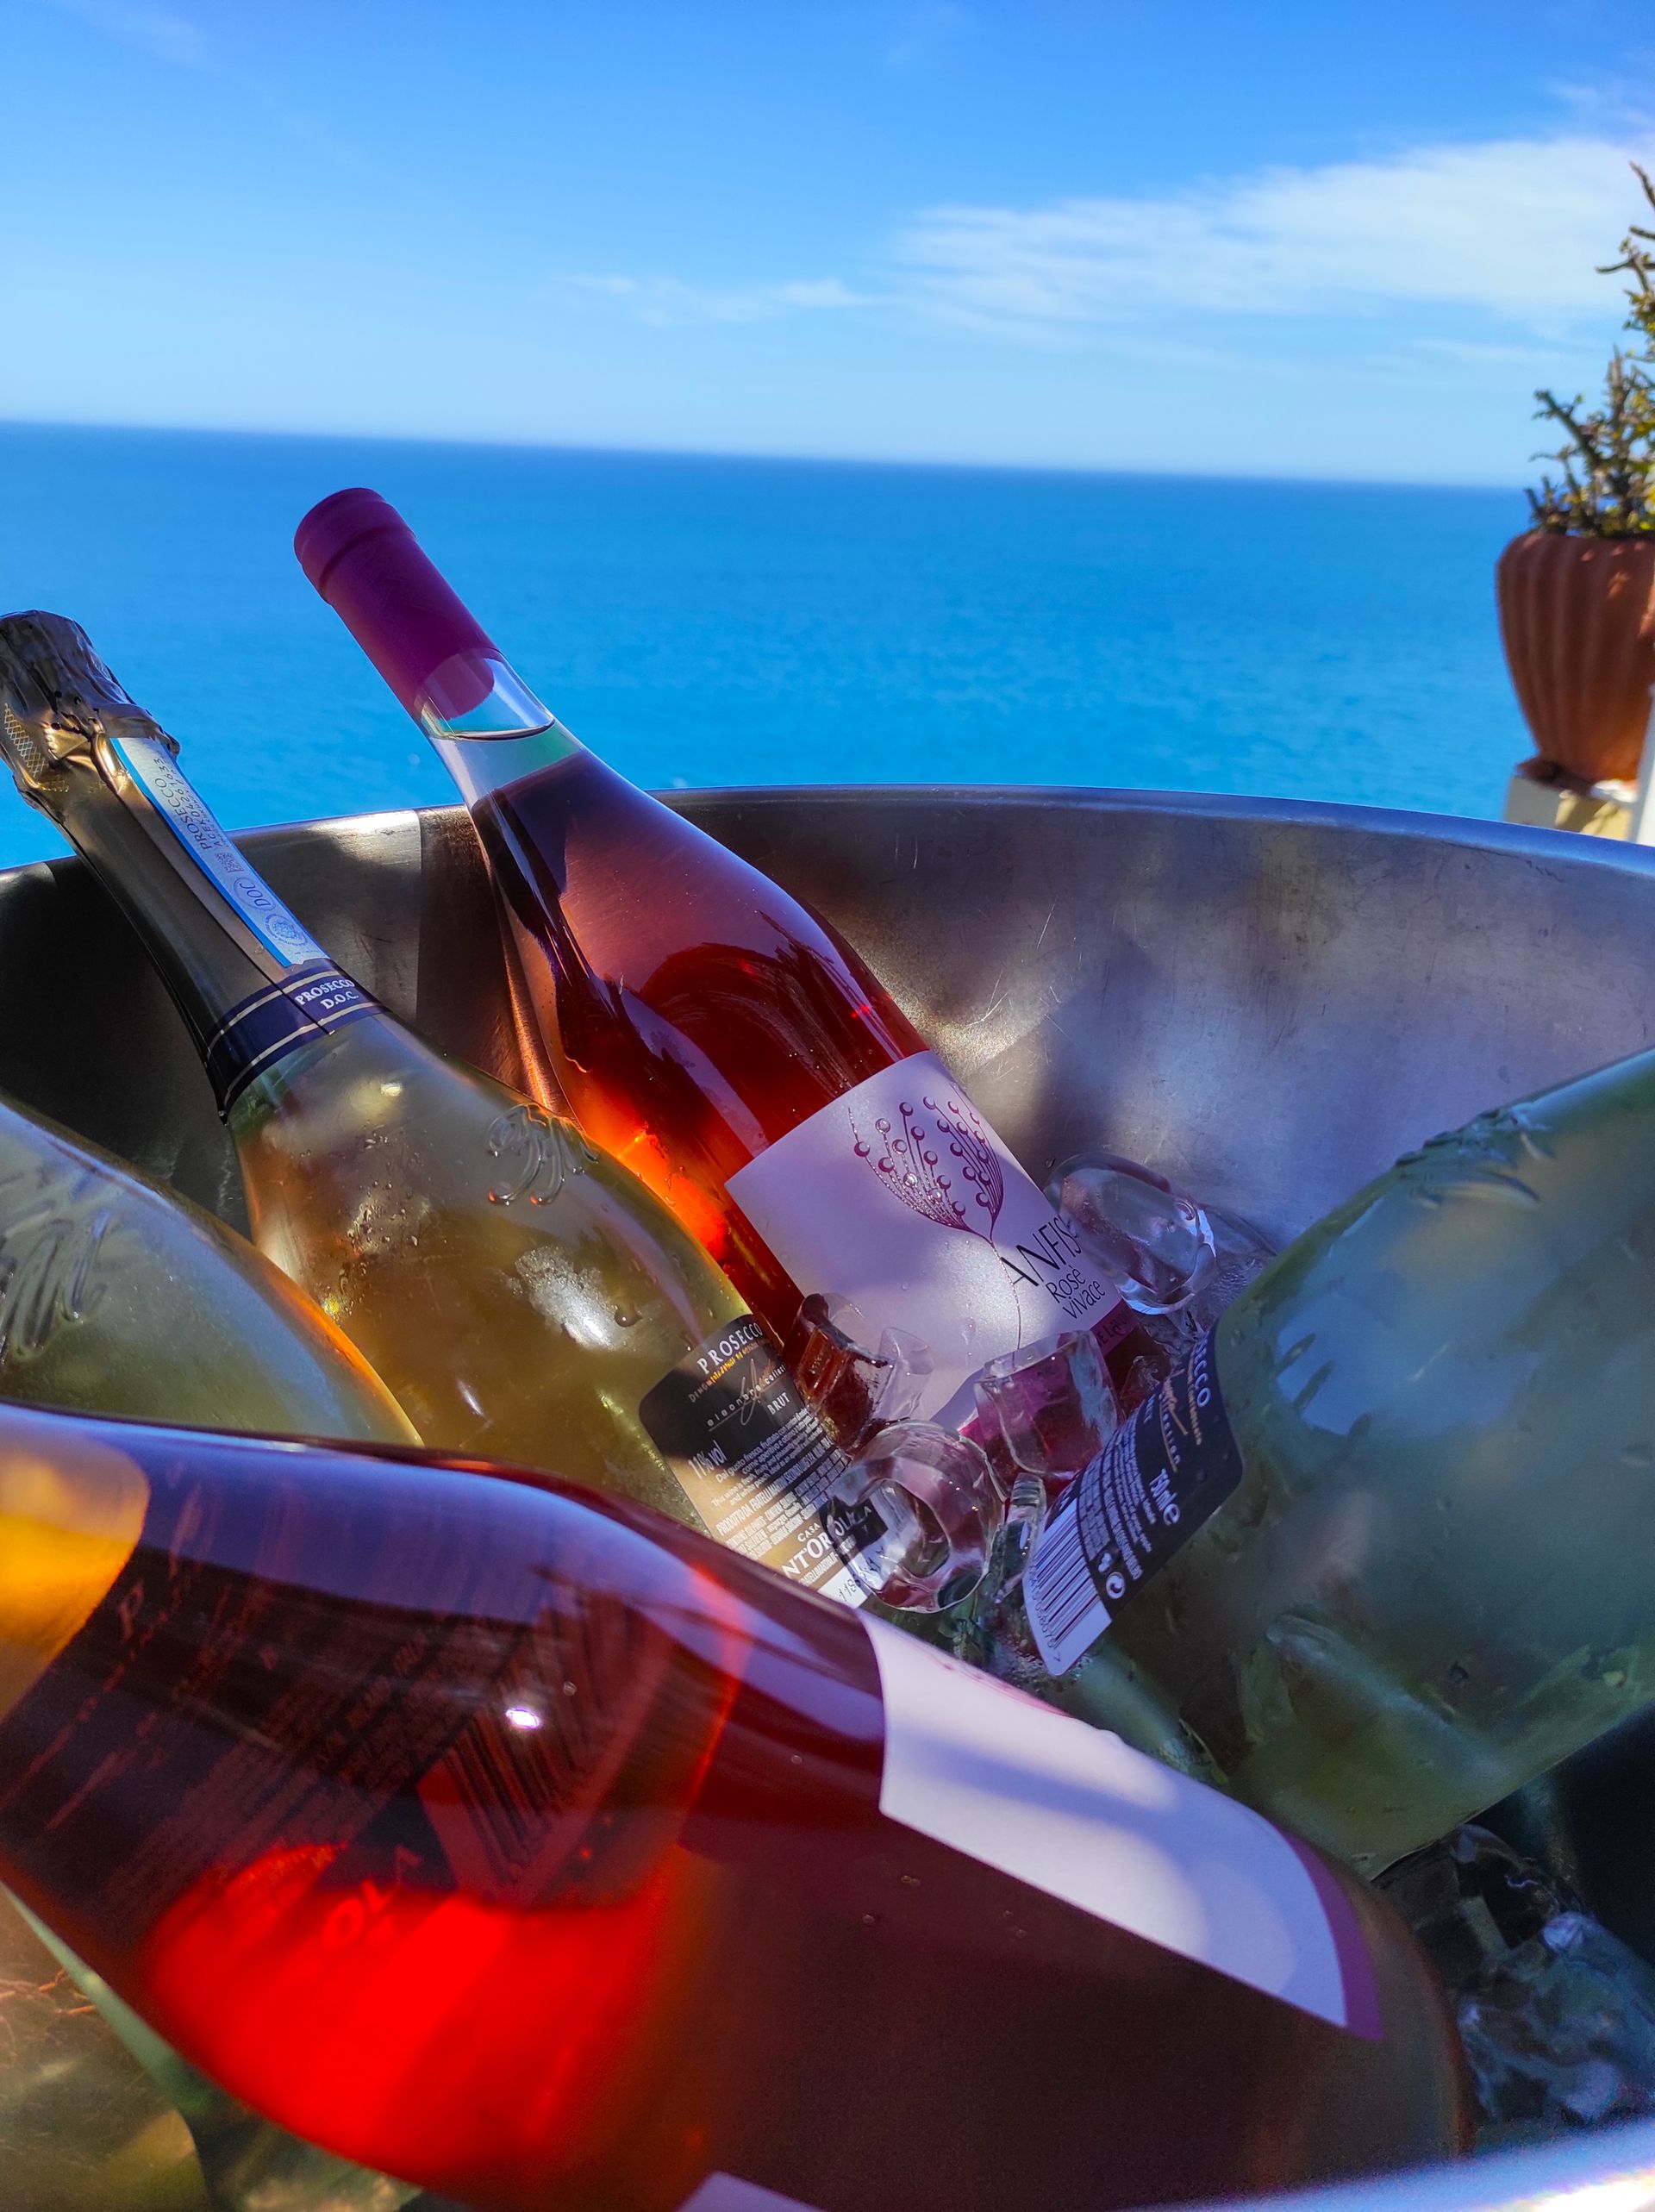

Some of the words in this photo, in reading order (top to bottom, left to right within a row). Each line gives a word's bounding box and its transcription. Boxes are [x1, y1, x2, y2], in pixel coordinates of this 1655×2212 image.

[154, 776, 213, 851] PROSECCO
[240, 881, 271, 908] DOC
[293, 978, 355, 1007] PROSECCO
[320, 988, 359, 1009] D.O.C.
[1062, 1280, 1106, 1320] vivace
[696, 1322, 763, 1376] PROSECCO
[766, 1390, 790, 1415] BRUT
[707, 1440, 727, 1466] vol
[741, 1459, 759, 1474] come
[757, 1441, 780, 1463] aperitivo
[715, 1469, 728, 1482] Dal
[727, 1458, 745, 1477] gusto
[796, 1522, 821, 1542] CASA
